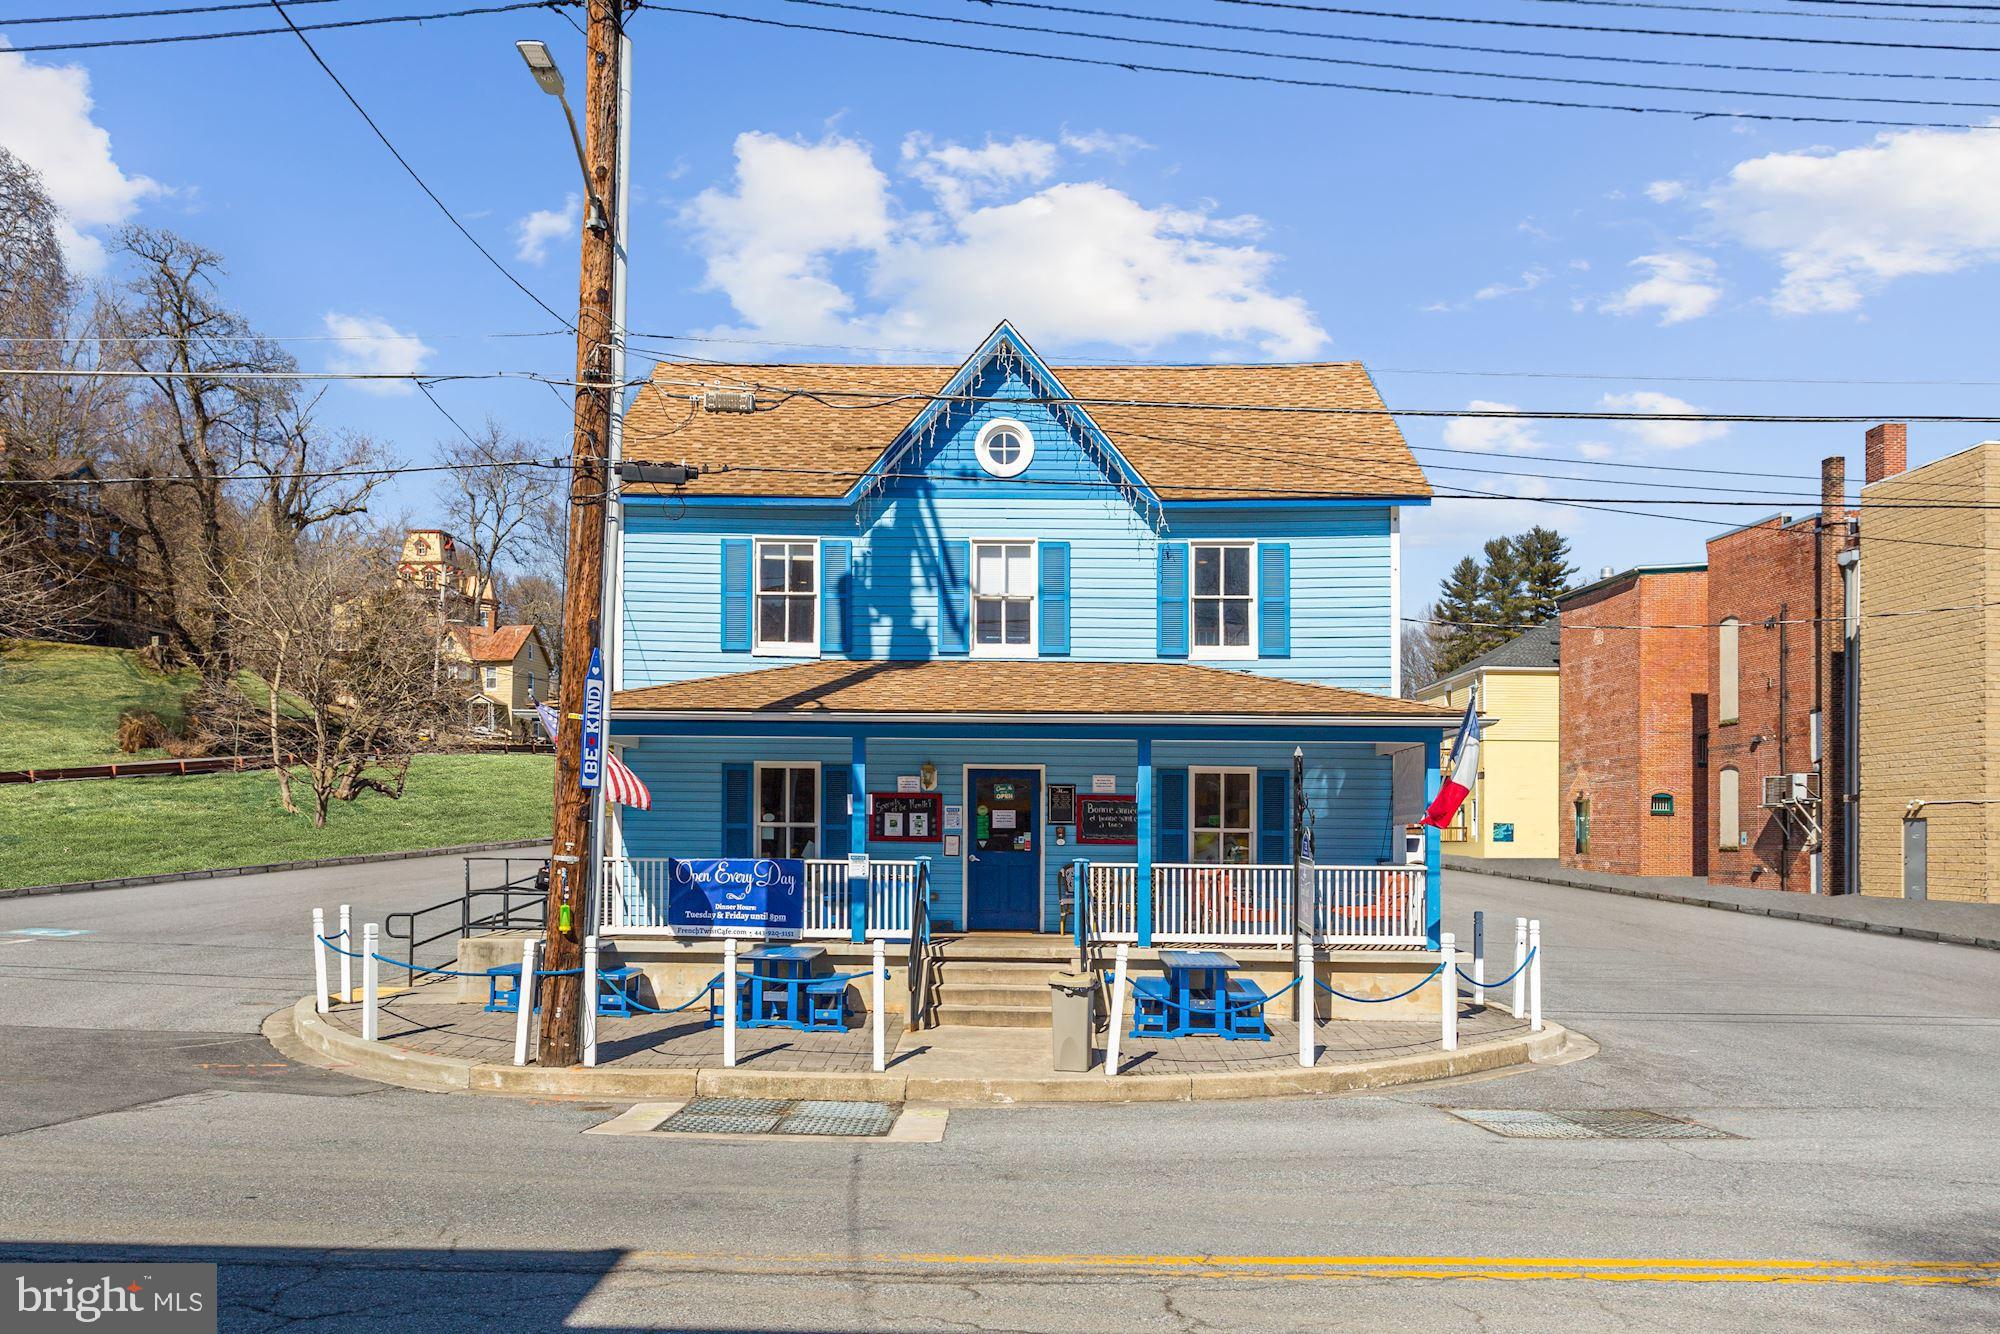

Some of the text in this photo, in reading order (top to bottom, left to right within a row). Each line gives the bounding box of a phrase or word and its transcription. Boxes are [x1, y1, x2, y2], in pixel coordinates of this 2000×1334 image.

[584, 686, 601, 773] BE KIND
[1087, 803, 1114, 814] Bonne
[676, 859, 796, 896] Open Every Day
[715, 903, 757, 911] Dinner Hours:
[684, 910, 787, 922] Tuesday & Friday until 8pm
[677, 927, 747, 937] FrenchTwistCafe.com
